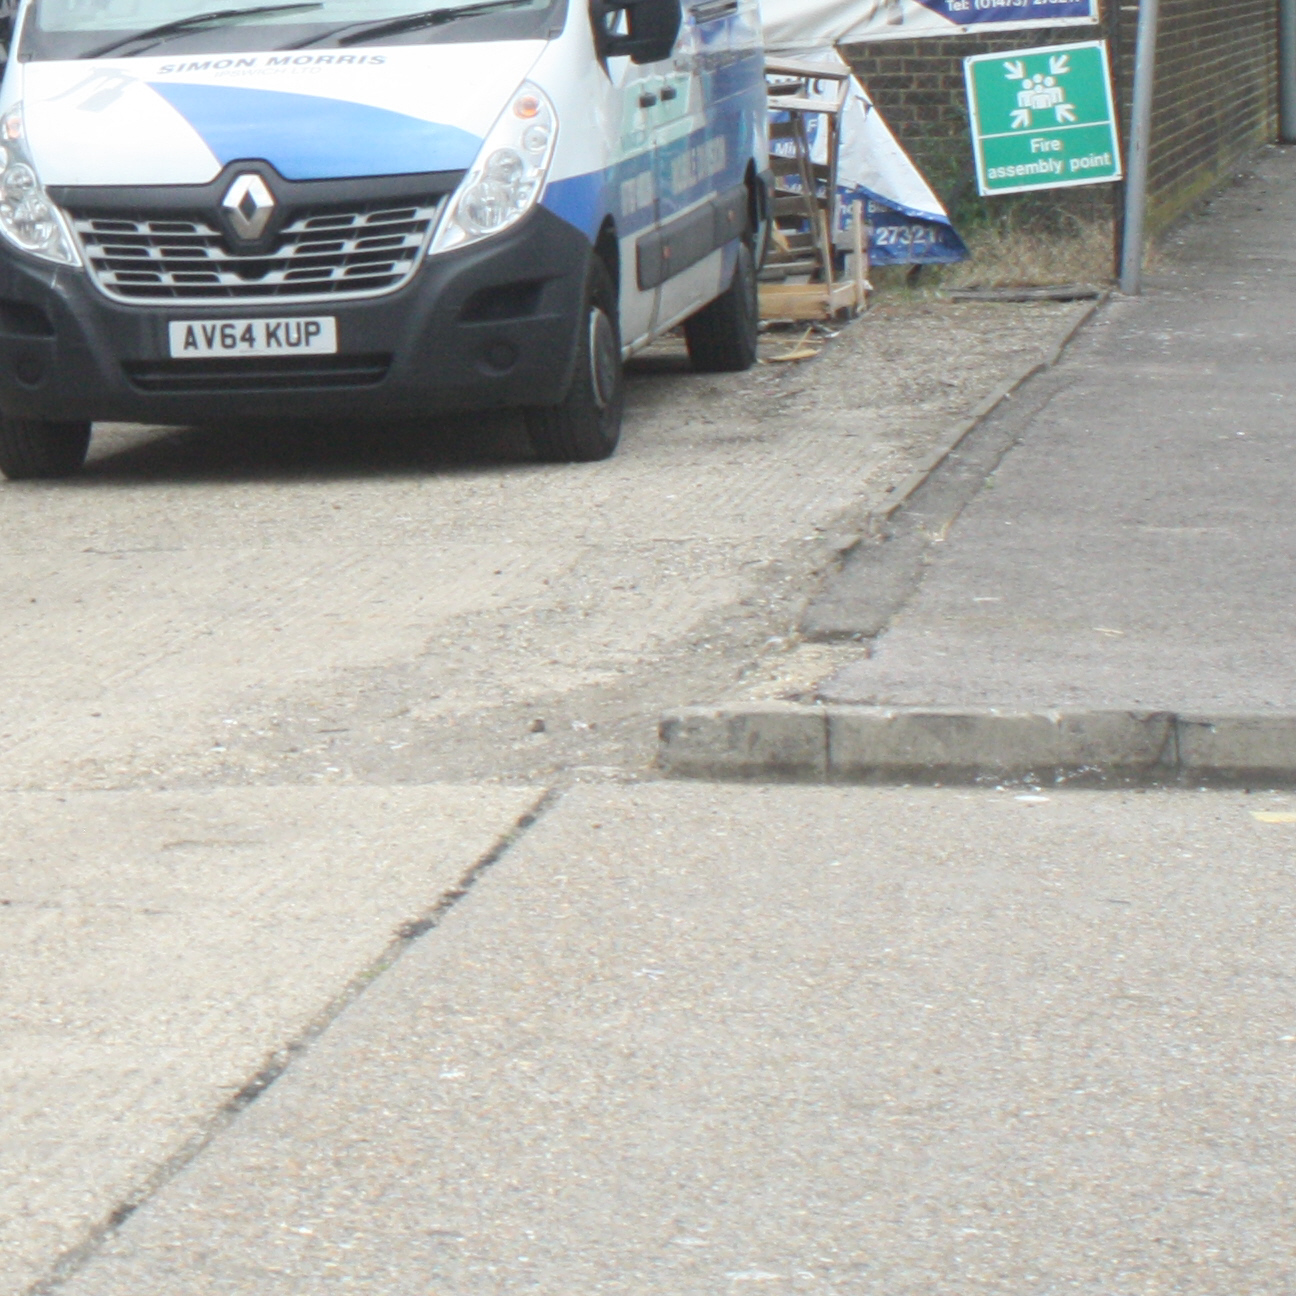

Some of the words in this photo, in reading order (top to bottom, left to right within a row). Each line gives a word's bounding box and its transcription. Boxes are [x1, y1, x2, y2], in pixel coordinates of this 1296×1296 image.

[157, 57, 256, 75] SIMON
[264, 54, 388, 67] MORRIS
[214, 67, 286, 78] IPSWICH
[290, 65, 323, 75] LTD
[1029, 137, 1062, 153] Fire
[988, 157, 1064, 180] assembly
[1069, 152, 1112, 172] point
[183, 323, 256, 351] AV64
[265, 320, 321, 348] KUP
